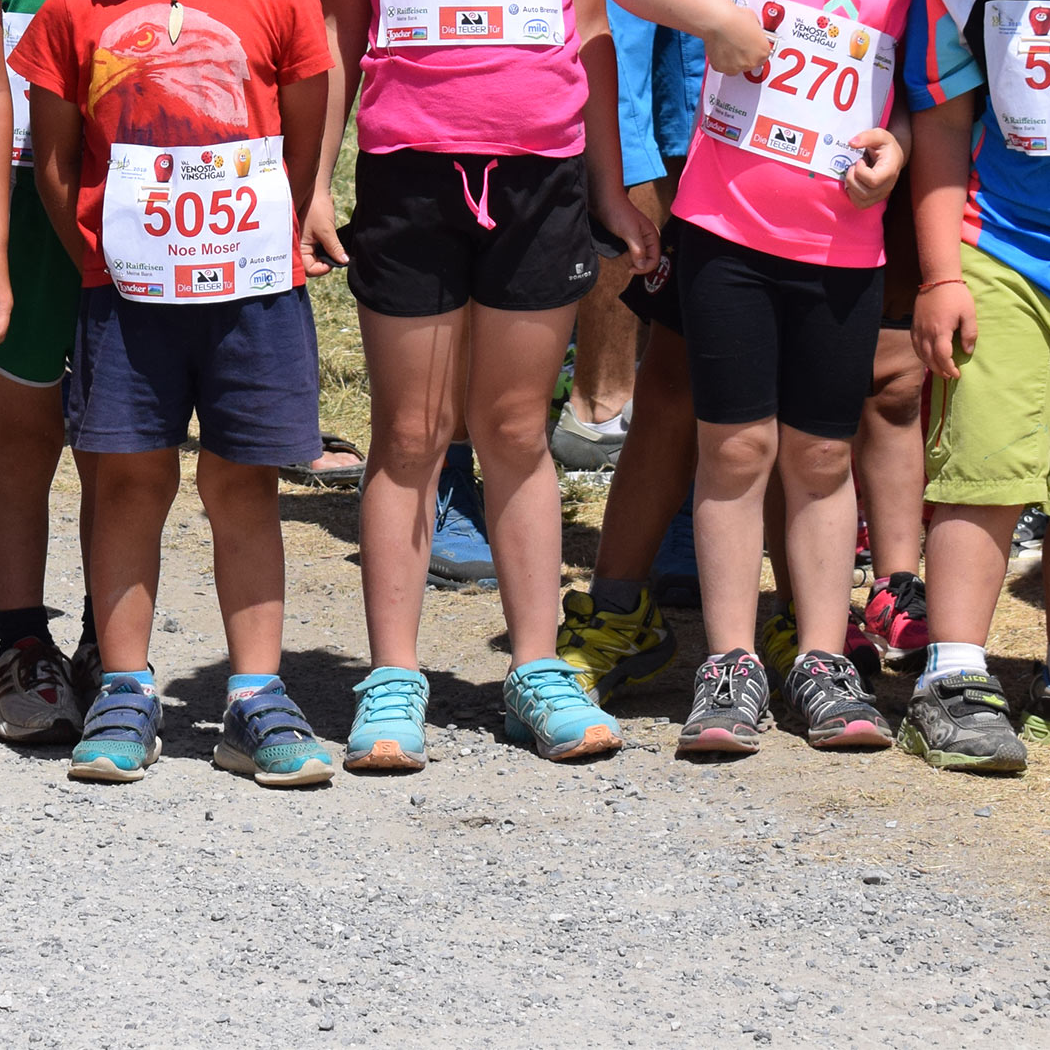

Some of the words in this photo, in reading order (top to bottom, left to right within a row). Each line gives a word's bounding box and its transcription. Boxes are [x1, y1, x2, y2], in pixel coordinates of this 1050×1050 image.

[396, 7, 428, 15] Raiffeisen
[522, 6, 538, 14] Auto
[441, 25, 455, 34] Die
[458, 25, 486, 34] TELSER
[488, 25, 501, 34] Tür
[528, 23, 548, 33] mila
[794, 22, 828, 39] VENOSTA
[792, 29, 837, 49] VINSCHGAU
[1025, 46, 1050, 90] 5
[715, 99, 747, 117] Raiffeisen
[1010, 117, 1046, 125] Raiffeisen
[753, 135, 768, 145] Die
[769, 140, 798, 154] TELSER
[799, 147, 812, 158] Tür
[181, 165, 216, 174] VENOSTA
[181, 170, 225, 180] VINSCHGAU
[143, 186, 260, 238] 5052
[168, 244, 197, 256] Noe
[201, 241, 241, 256] Moser
[249, 257, 265, 265] Auto
[266, 253, 288, 263] Brenner
[125, 262, 164, 272] Raiffeisen
[253, 273, 274, 284] mila
[177, 283, 192, 292] Die
[194, 282, 222, 292] TELSER
[223, 281, 234, 289] Tür
